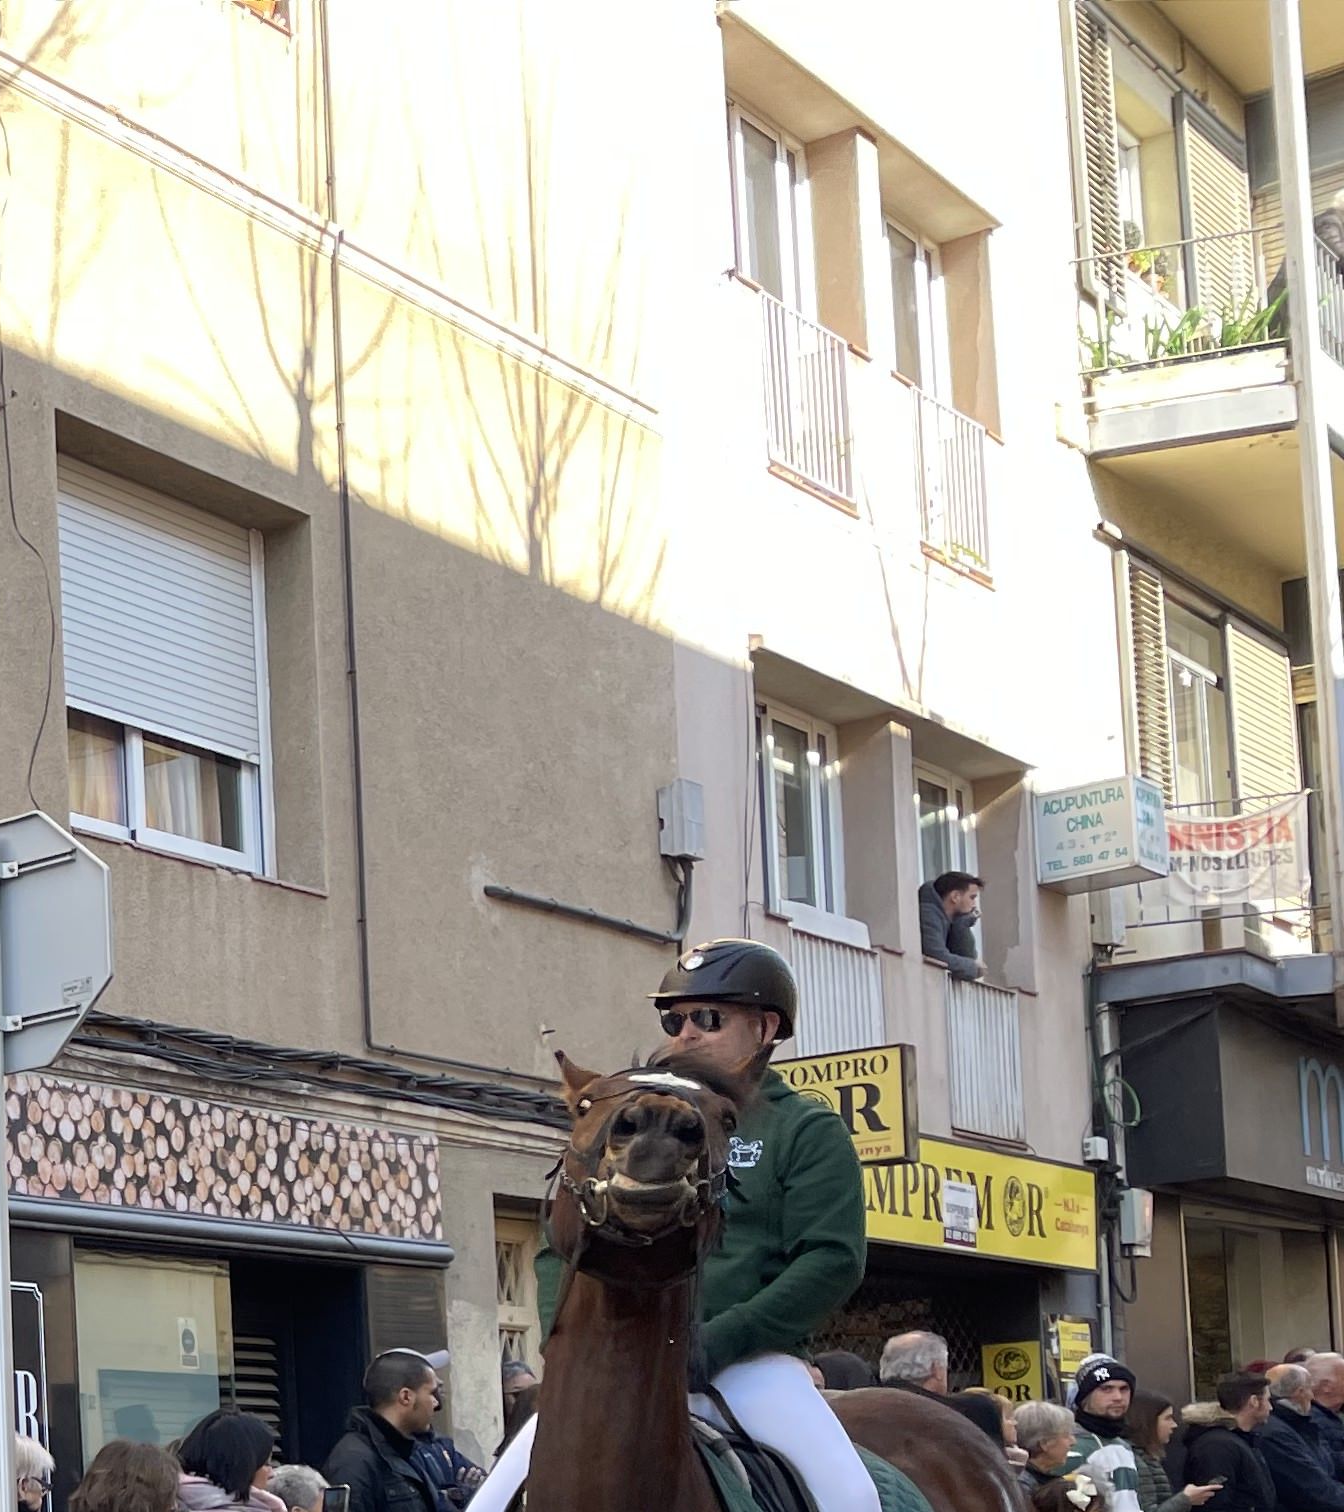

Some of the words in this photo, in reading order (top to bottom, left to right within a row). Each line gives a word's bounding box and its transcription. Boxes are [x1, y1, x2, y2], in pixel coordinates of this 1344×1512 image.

[1042, 786, 1125, 816] ACUPUNTURA
[1066, 812, 1104, 832] CHINA
[1115, 847, 1128, 858] 54
